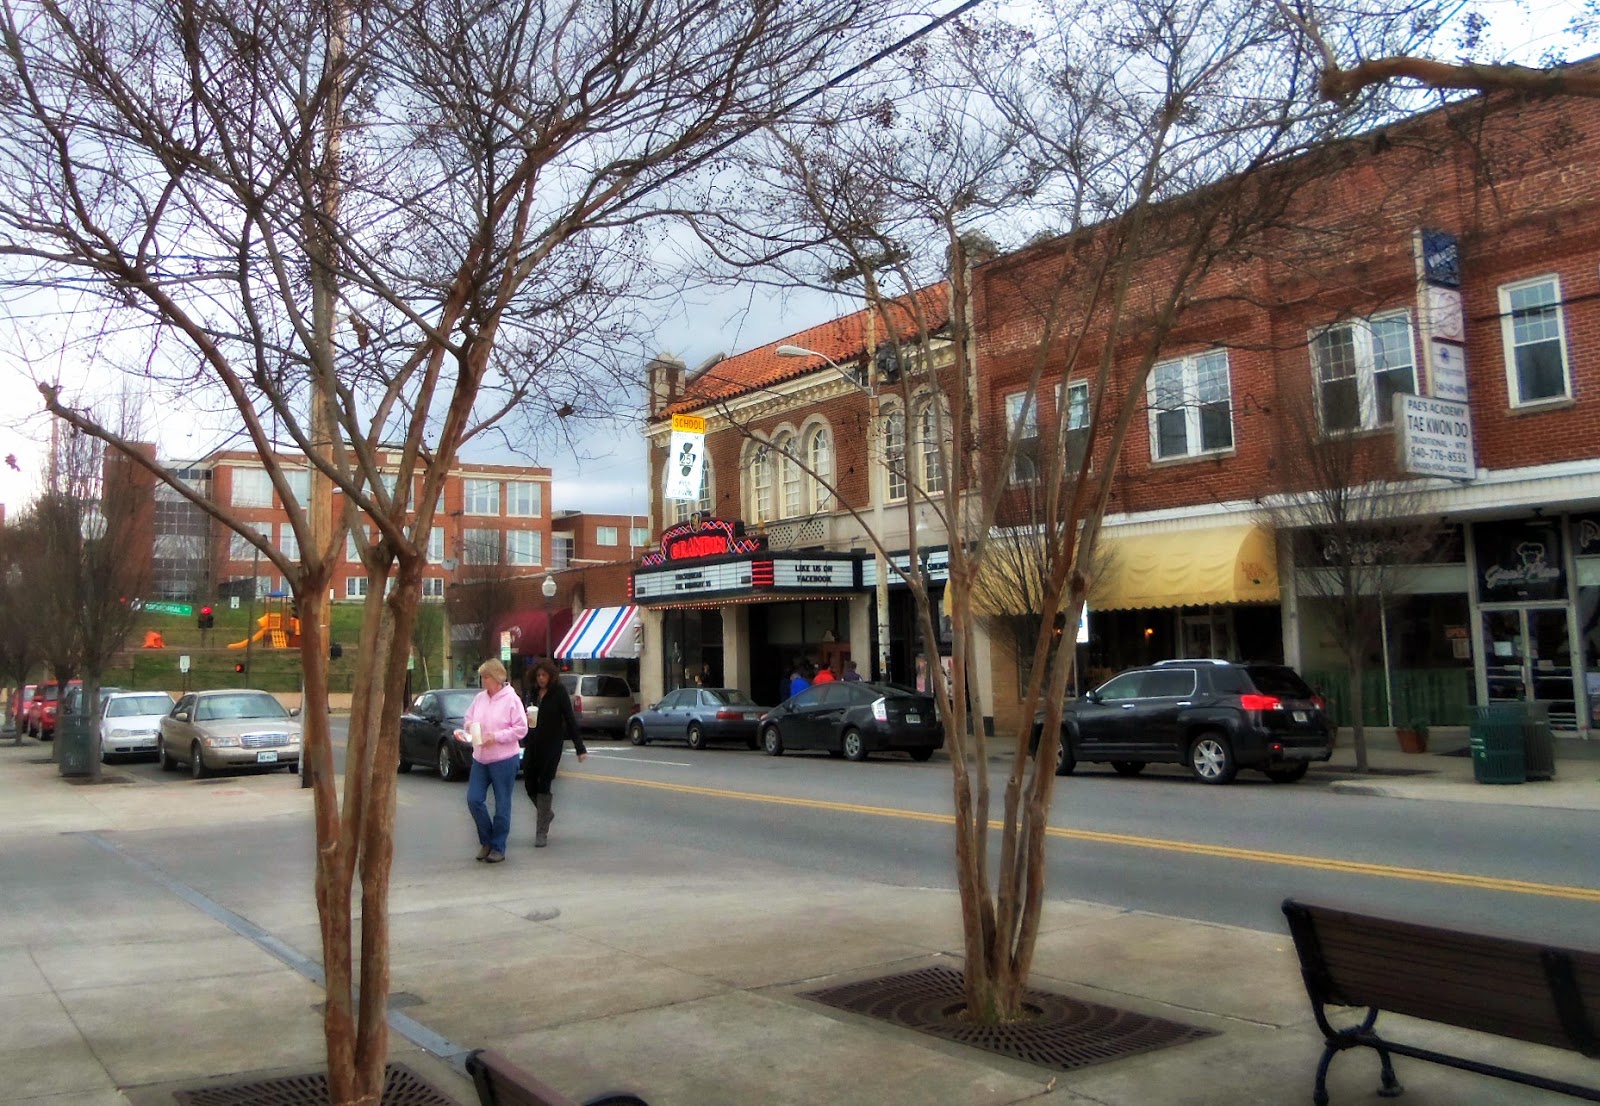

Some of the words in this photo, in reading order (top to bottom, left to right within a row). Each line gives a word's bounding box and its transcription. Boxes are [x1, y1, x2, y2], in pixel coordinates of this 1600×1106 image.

[1408, 400, 1427, 412] PAE'S
[1430, 403, 1464, 417] ACADEMY
[674, 418, 703, 430] SCHOOL
[1407, 415, 1424, 431] TAE
[1427, 417, 1453, 435] KWON
[1455, 422, 1468, 437] DO
[680, 453, 692, 465] 25
[797, 575, 832, 583] FACEBOOK
